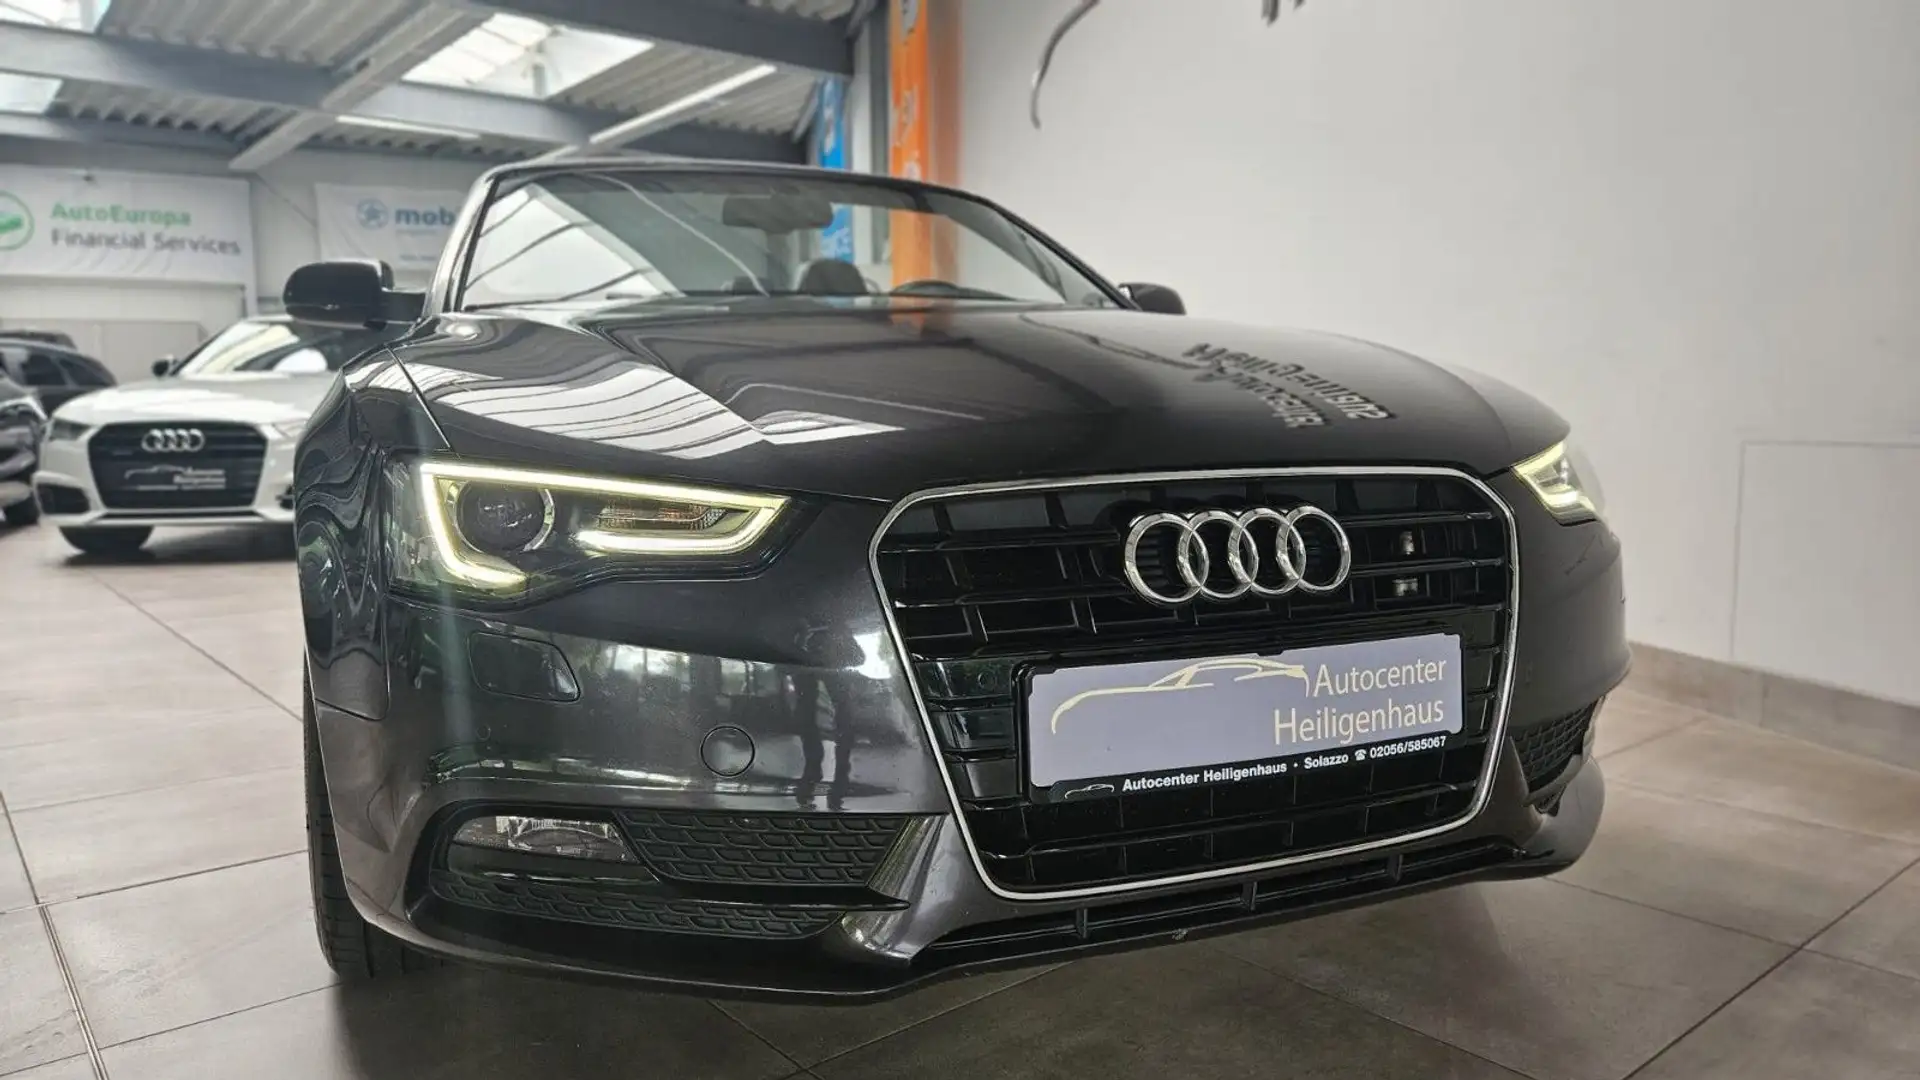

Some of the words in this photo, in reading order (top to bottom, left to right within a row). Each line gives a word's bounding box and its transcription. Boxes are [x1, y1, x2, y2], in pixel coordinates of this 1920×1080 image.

[51, 203, 192, 227] AutoEuropa
[51, 229, 147, 250] Financial
[153, 232, 241, 256] Services
[1313, 658, 1447, 698] Autocenter
[1274, 698, 1444, 745] Heiligenhaus
[1122, 772, 1199, 792] Autocenter
[1203, 762, 1287, 783] Heiligenhaus
[1304, 753, 1349, 769] Solazzo
[1369, 735, 1447, 759] 02056/585067
